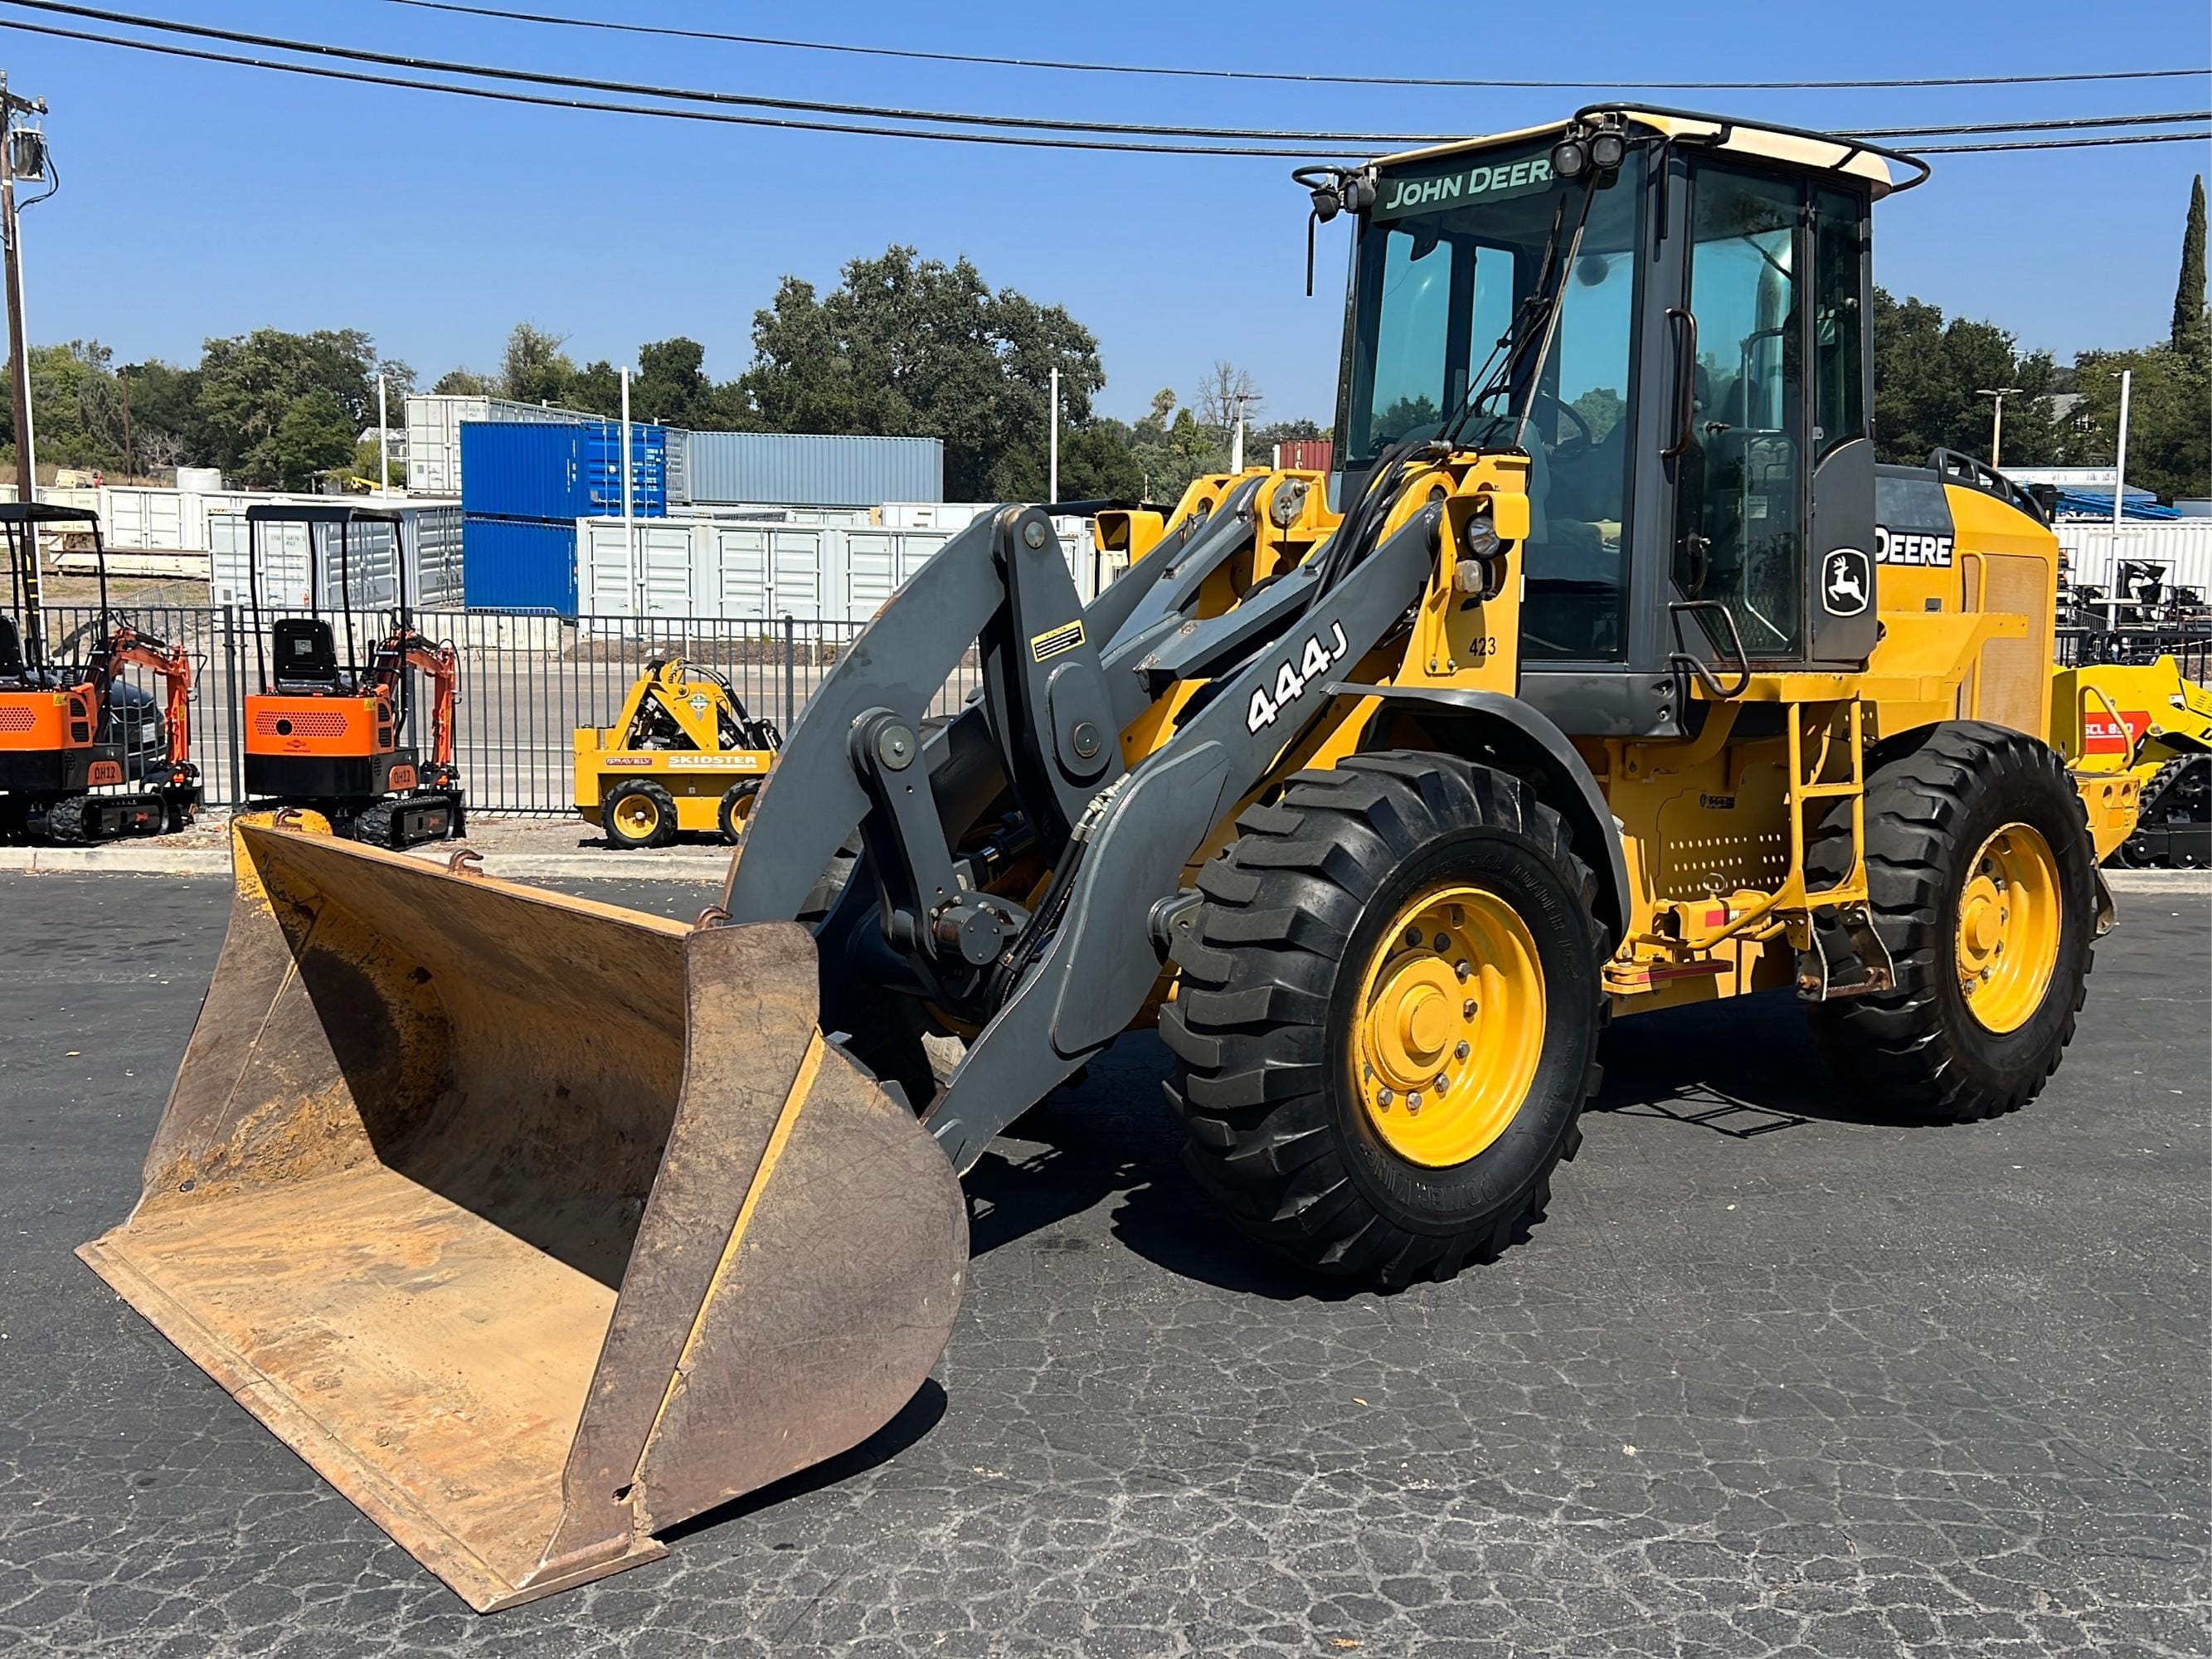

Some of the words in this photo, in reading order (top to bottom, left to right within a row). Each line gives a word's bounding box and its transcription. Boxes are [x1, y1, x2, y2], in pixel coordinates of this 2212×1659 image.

[1386, 175, 1462, 210] JOHN
[1468, 159, 1553, 194] DEER
[1875, 527, 1952, 565] DEERE
[1469, 636, 1496, 656] 423
[1247, 620, 1348, 734] 444J
[606, 757, 651, 766] GRAVELY
[668, 756, 756, 764] SKIDSTER
